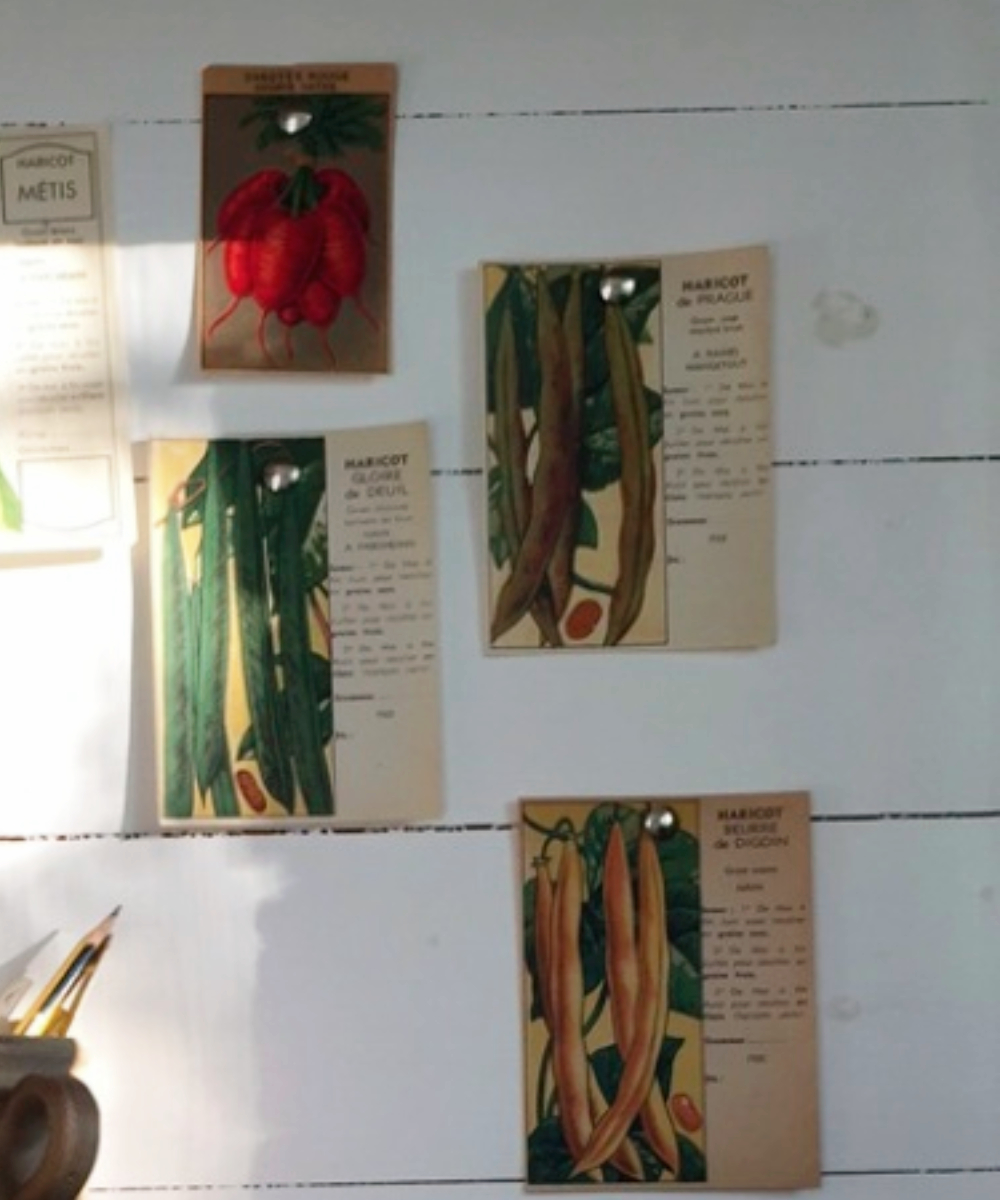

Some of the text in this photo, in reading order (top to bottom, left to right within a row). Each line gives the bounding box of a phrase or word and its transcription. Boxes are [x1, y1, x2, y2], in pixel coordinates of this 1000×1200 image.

[16, 154, 74, 169] HARICOT
[682, 273, 749, 291] HARICOT
[344, 453, 409, 469] HARICOT
[716, 806, 784, 820] HARICOT
[713, 838, 730, 849] de
